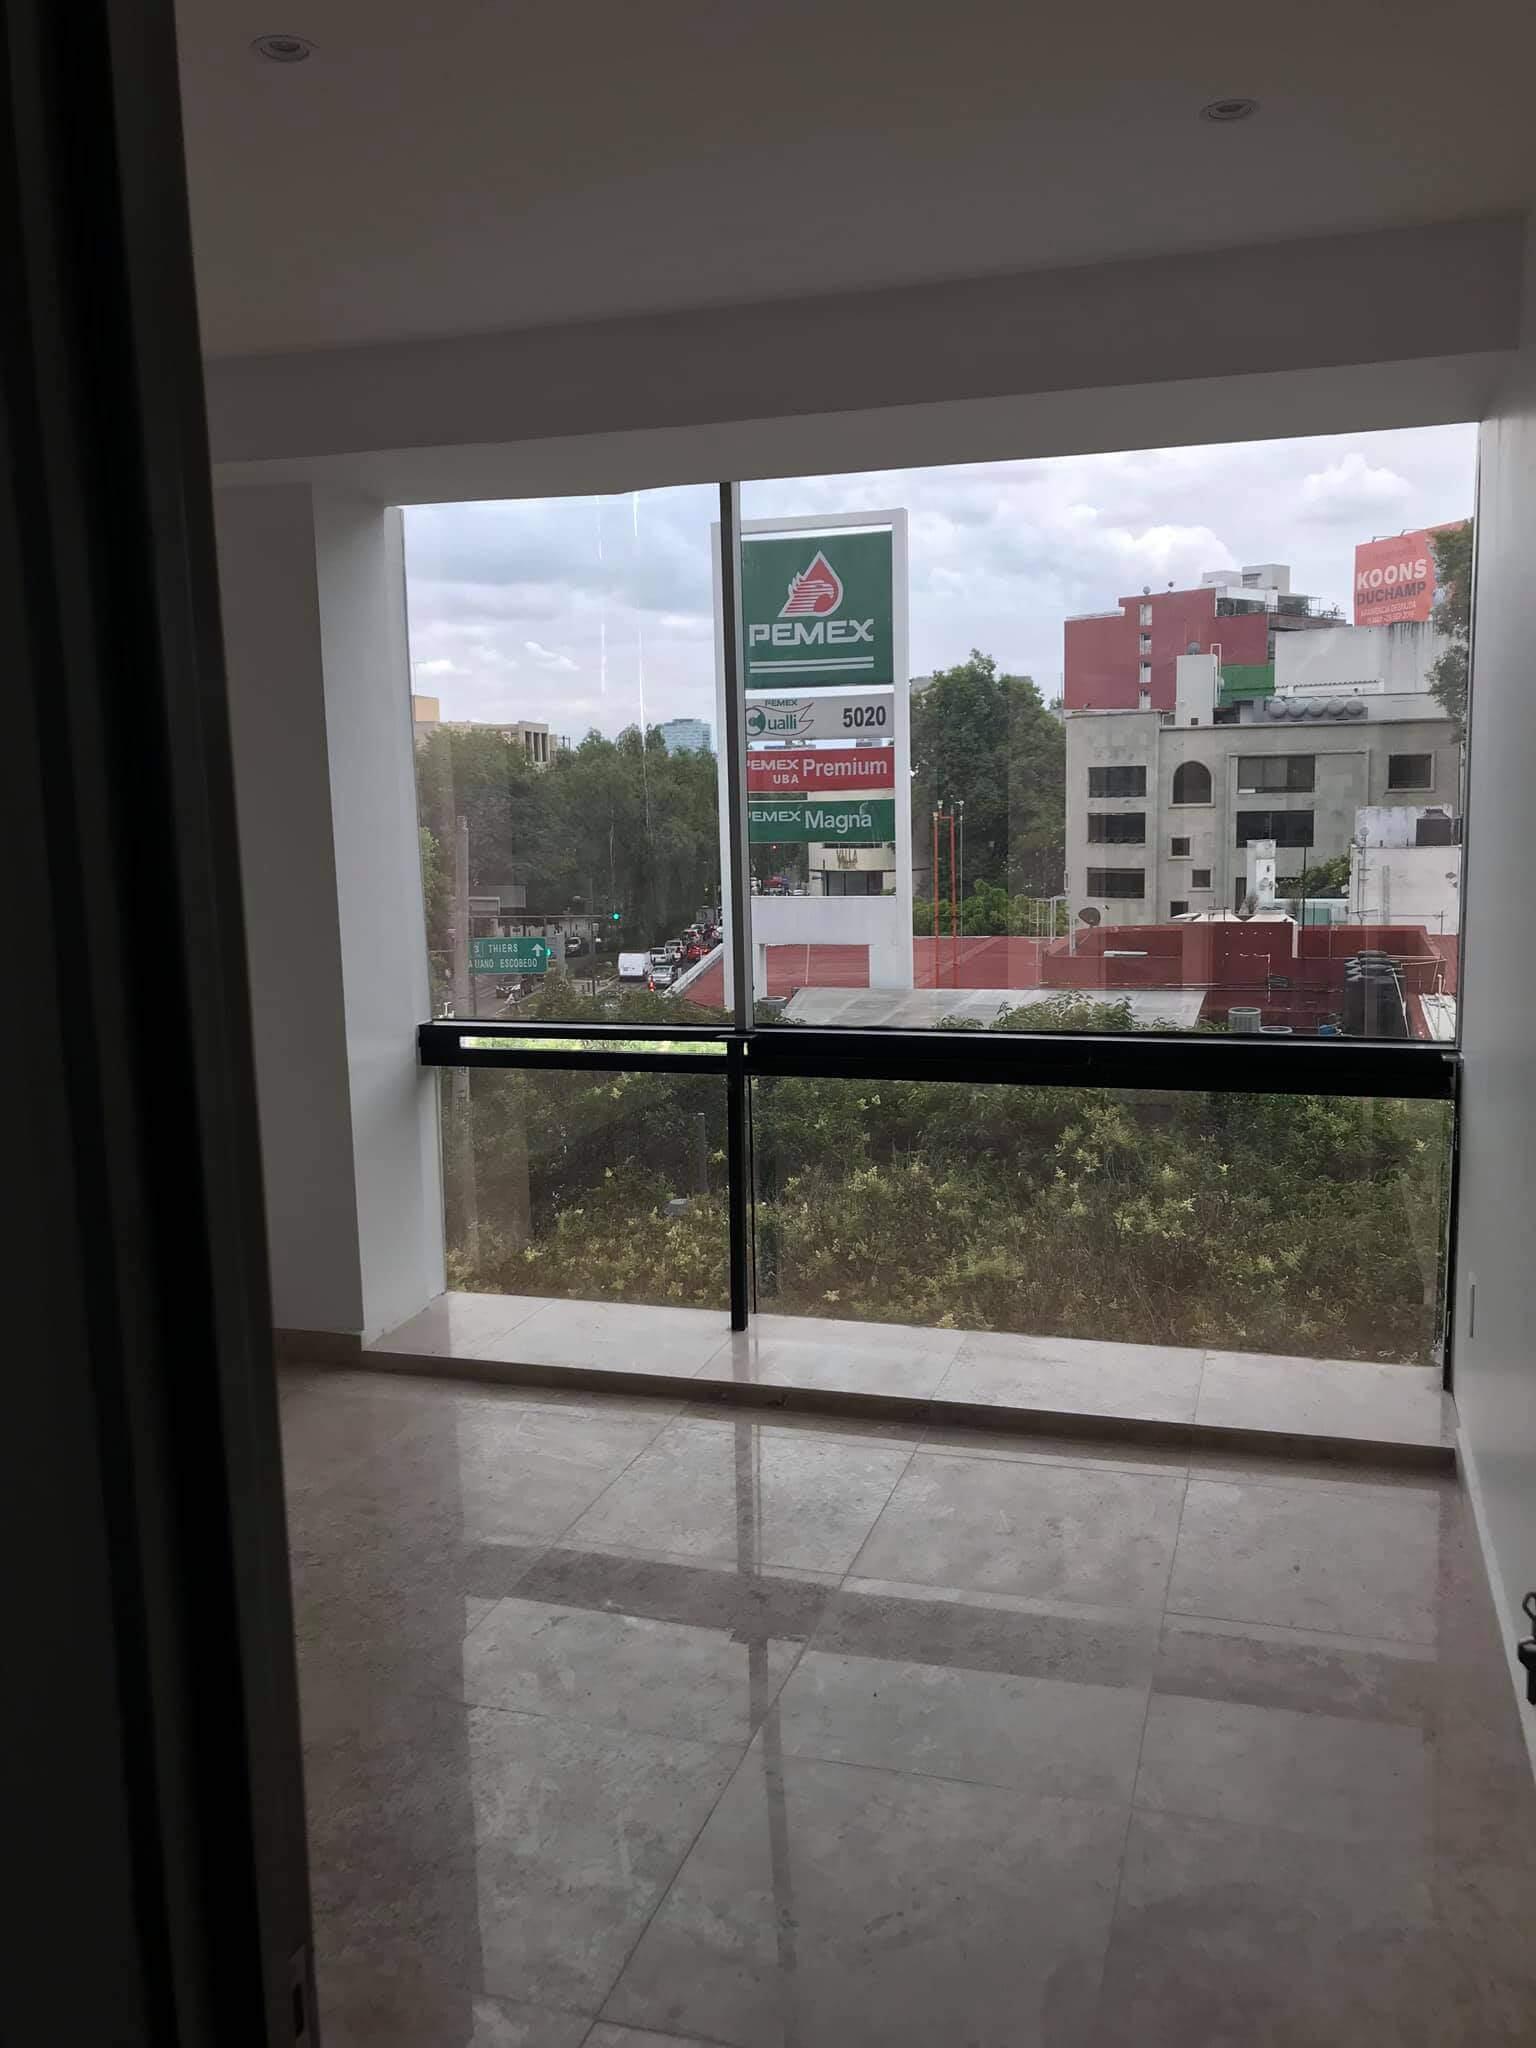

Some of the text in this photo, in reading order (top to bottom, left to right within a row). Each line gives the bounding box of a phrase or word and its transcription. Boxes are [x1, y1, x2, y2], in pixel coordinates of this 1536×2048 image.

[1356, 558, 1428, 590] KOONS
[1356, 581, 1427, 606] DUCHAMP
[749, 618, 875, 647] PEMEX
[842, 705, 886, 728] 5020
[802, 757, 887, 777] Premium
[773, 774, 799, 784] UBA
[749, 810, 872, 834] EMEX Magna
[488, 943, 519, 953] THIERS
[500, 958, 538, 968] ESCOBEDO
